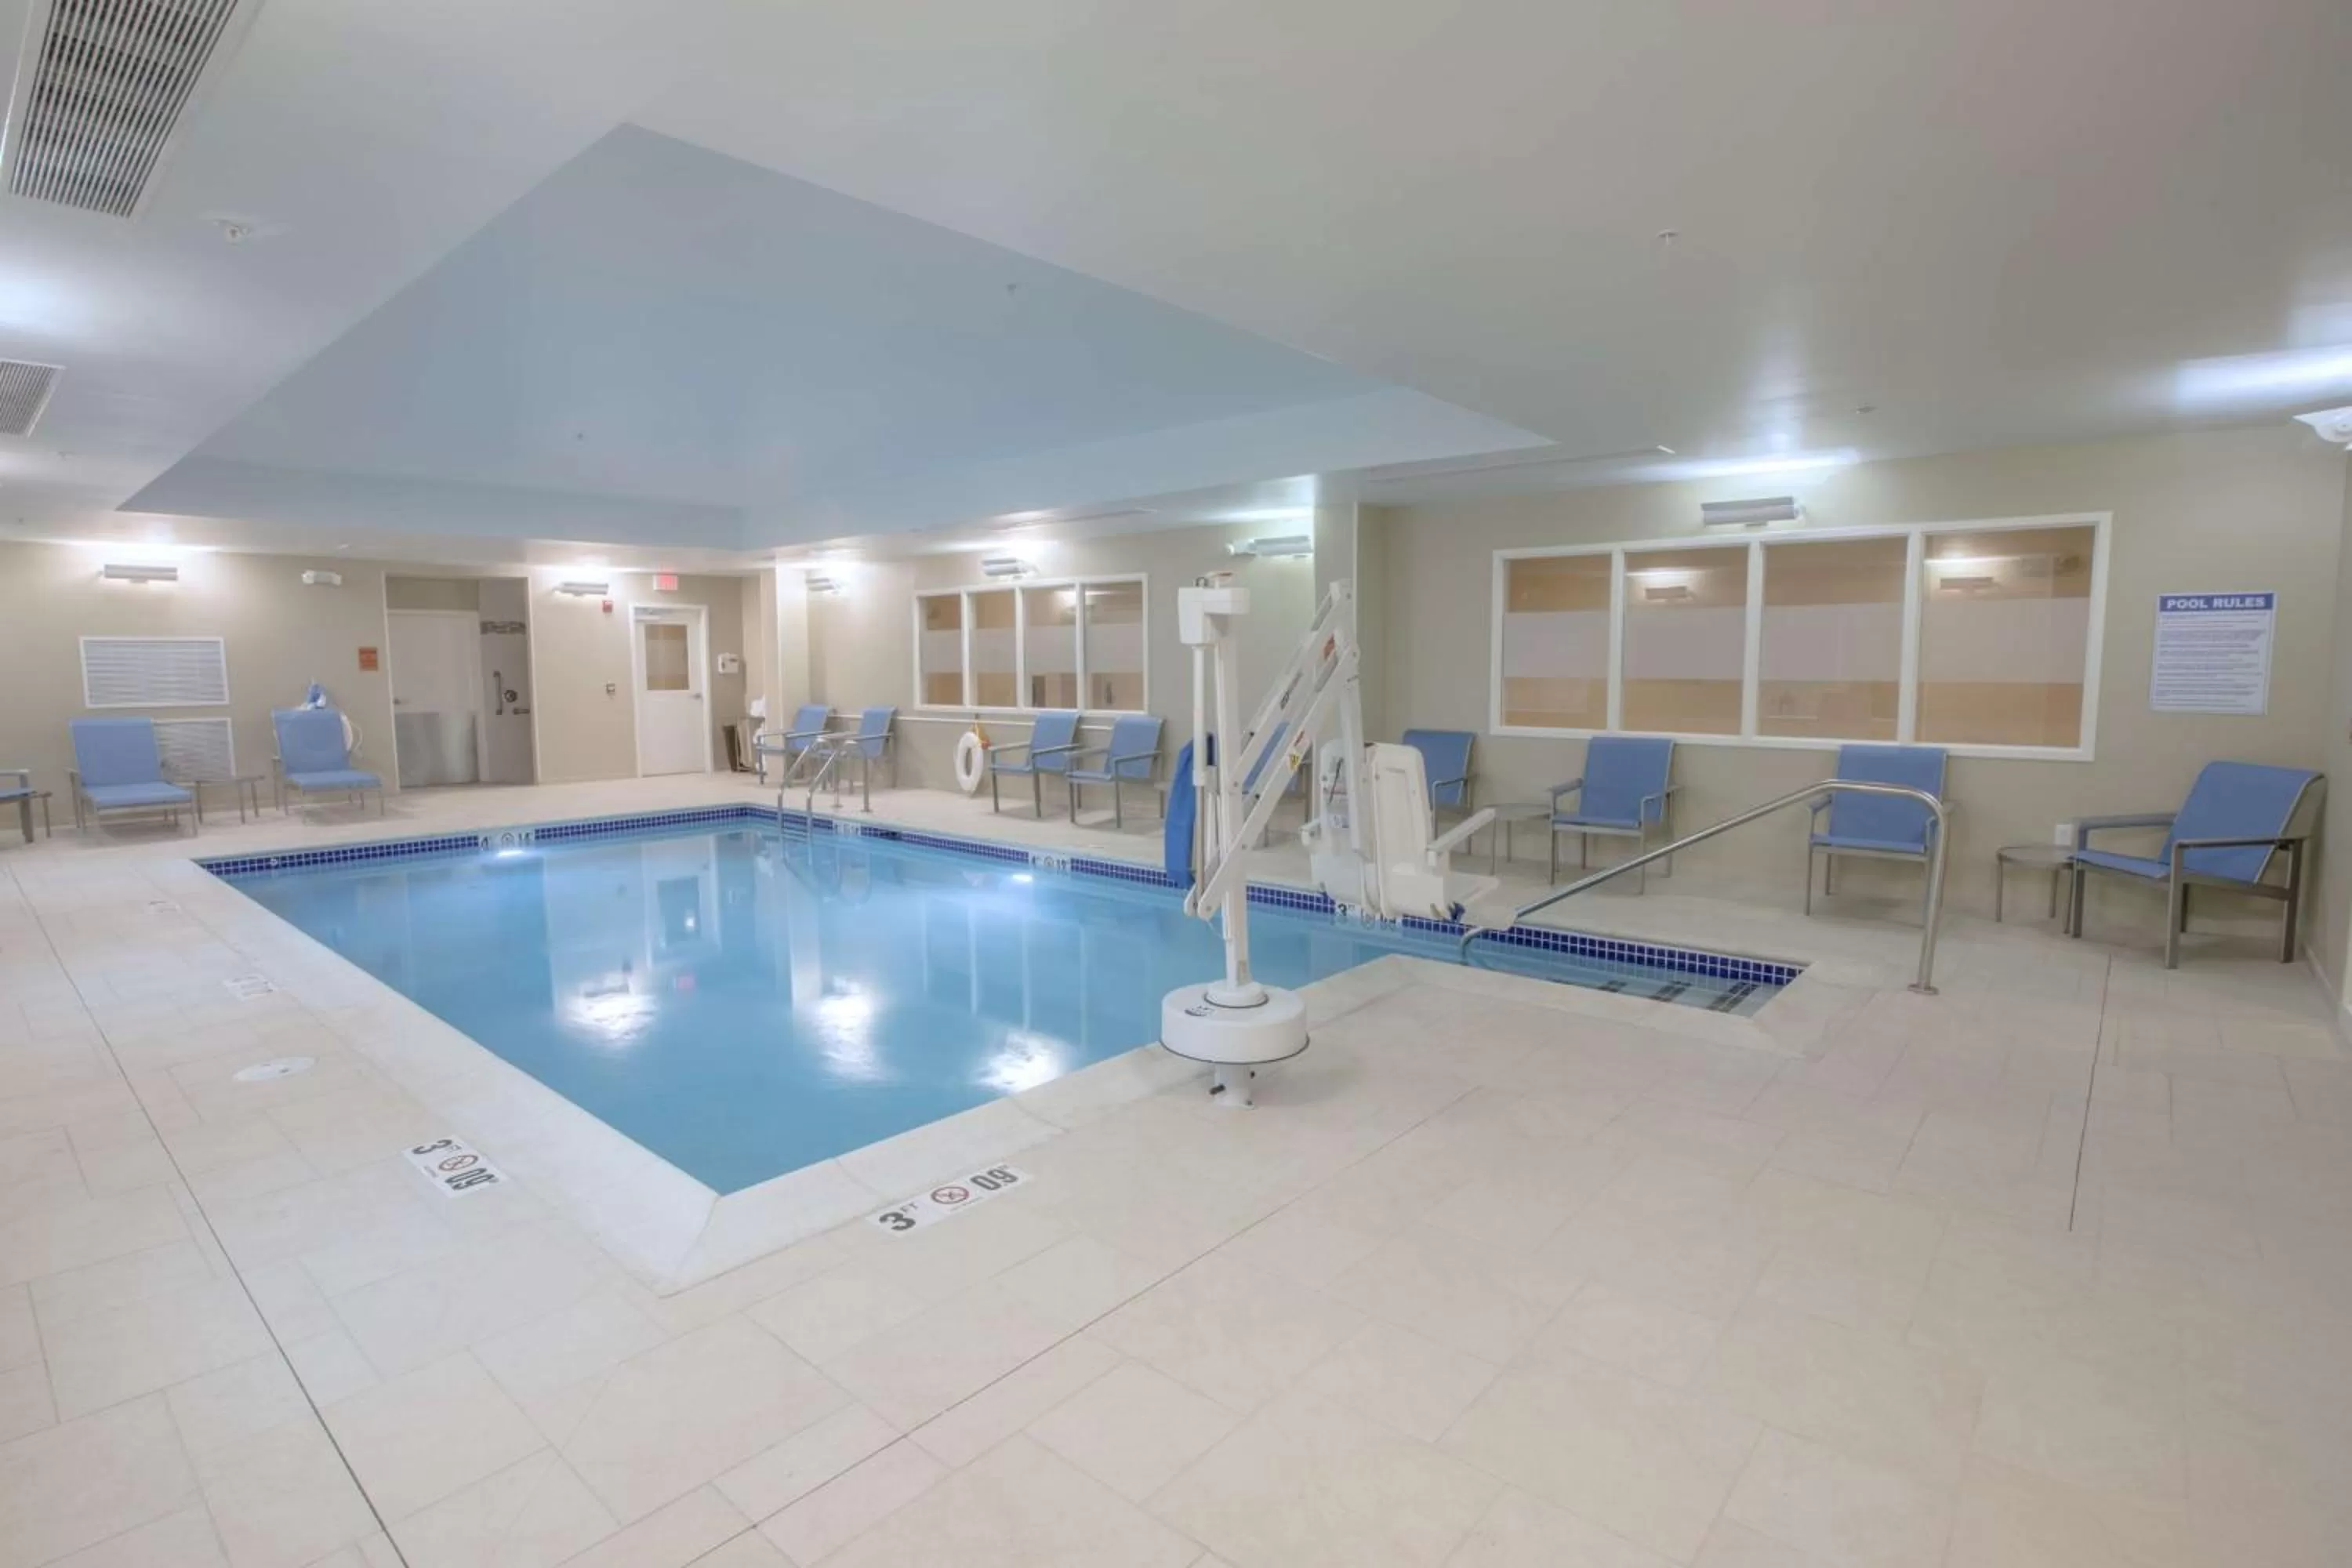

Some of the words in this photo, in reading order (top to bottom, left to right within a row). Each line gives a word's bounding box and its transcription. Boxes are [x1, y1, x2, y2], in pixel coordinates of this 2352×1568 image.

[2166, 598, 2209, 609] POOL
[2212, 597, 2266, 608] RULES
[412, 1139, 453, 1155] 3
[878, 1211, 916, 1232] 3
